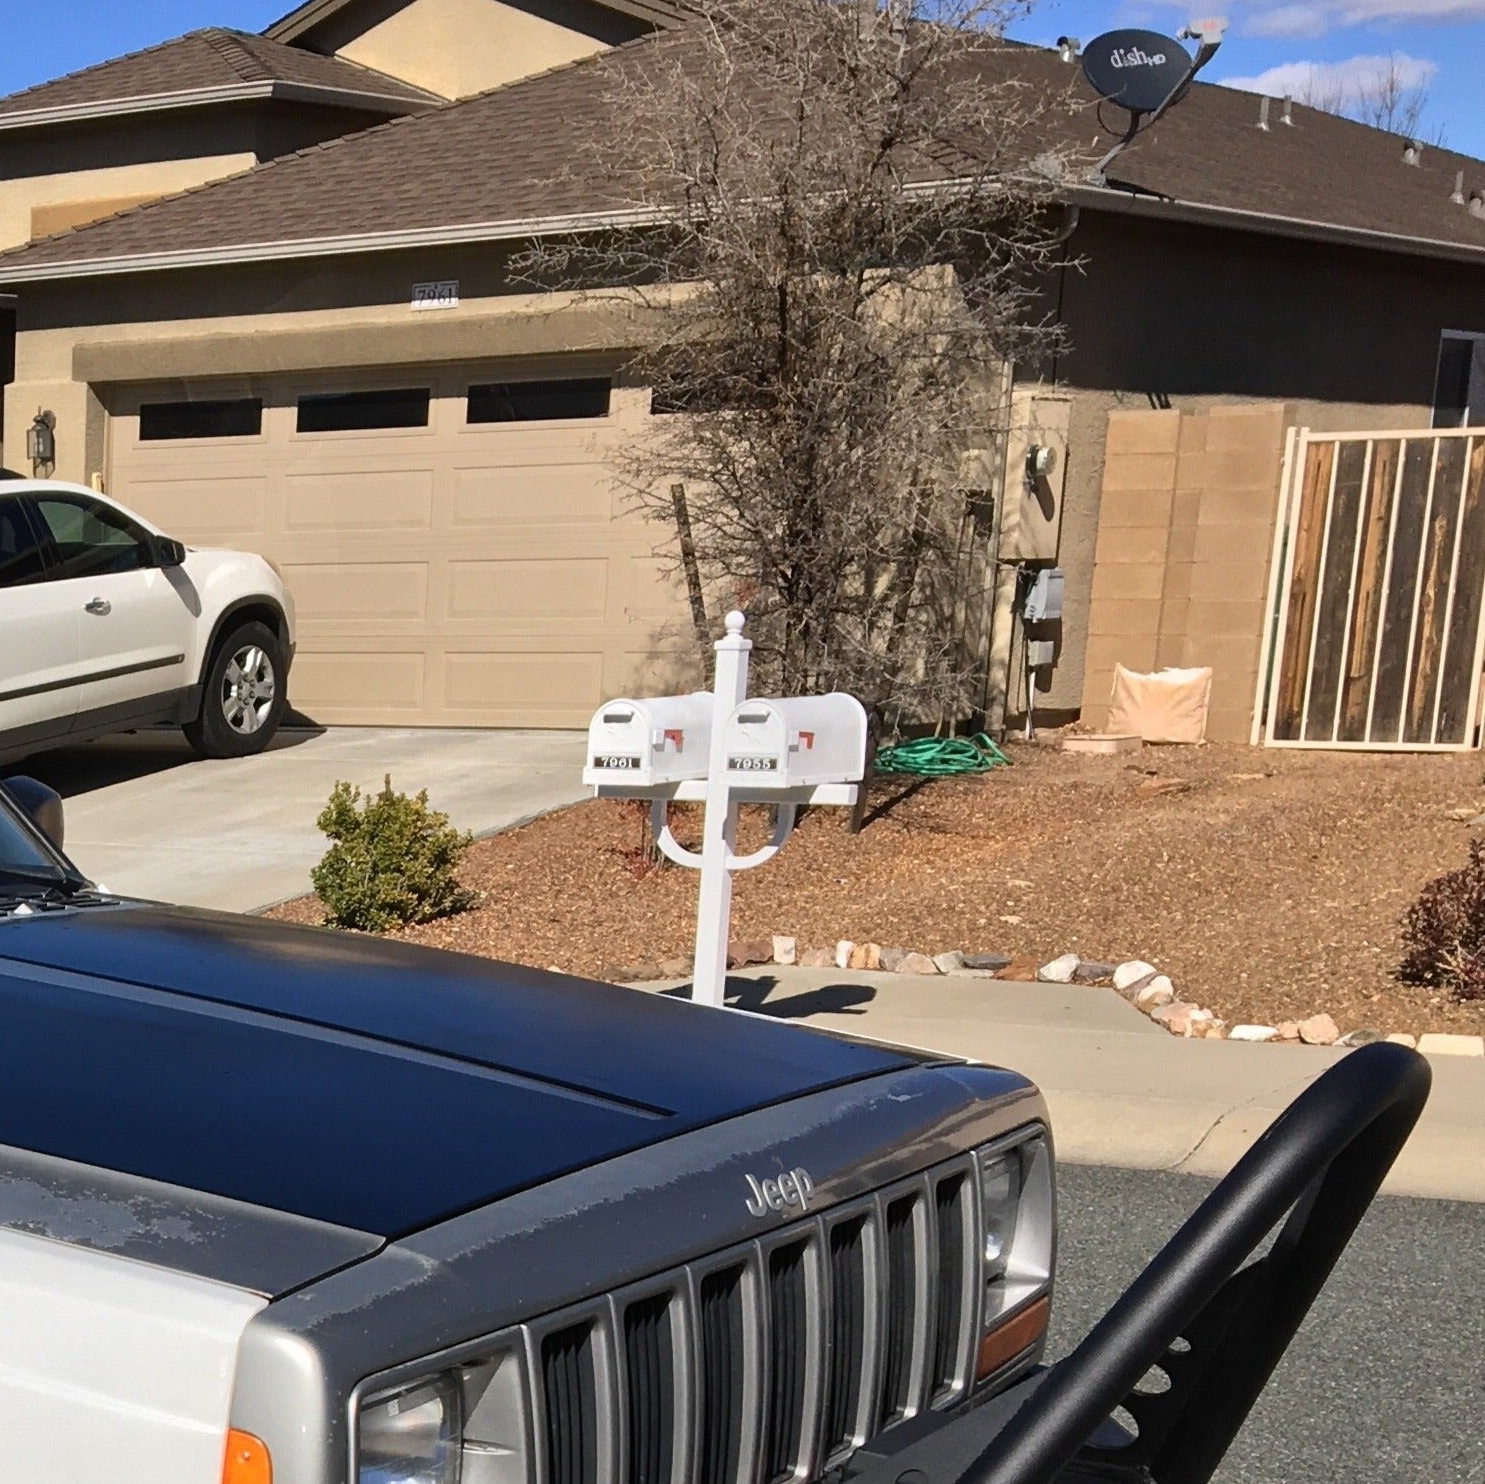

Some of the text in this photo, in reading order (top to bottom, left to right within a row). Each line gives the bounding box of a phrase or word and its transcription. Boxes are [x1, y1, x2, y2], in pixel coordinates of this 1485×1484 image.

[1110, 46, 1148, 68] dish
[417, 286, 453, 307] 7961
[600, 756, 634, 769] 7961
[733, 757, 772, 770] 7955
[745, 1166, 815, 1217] Jeep
